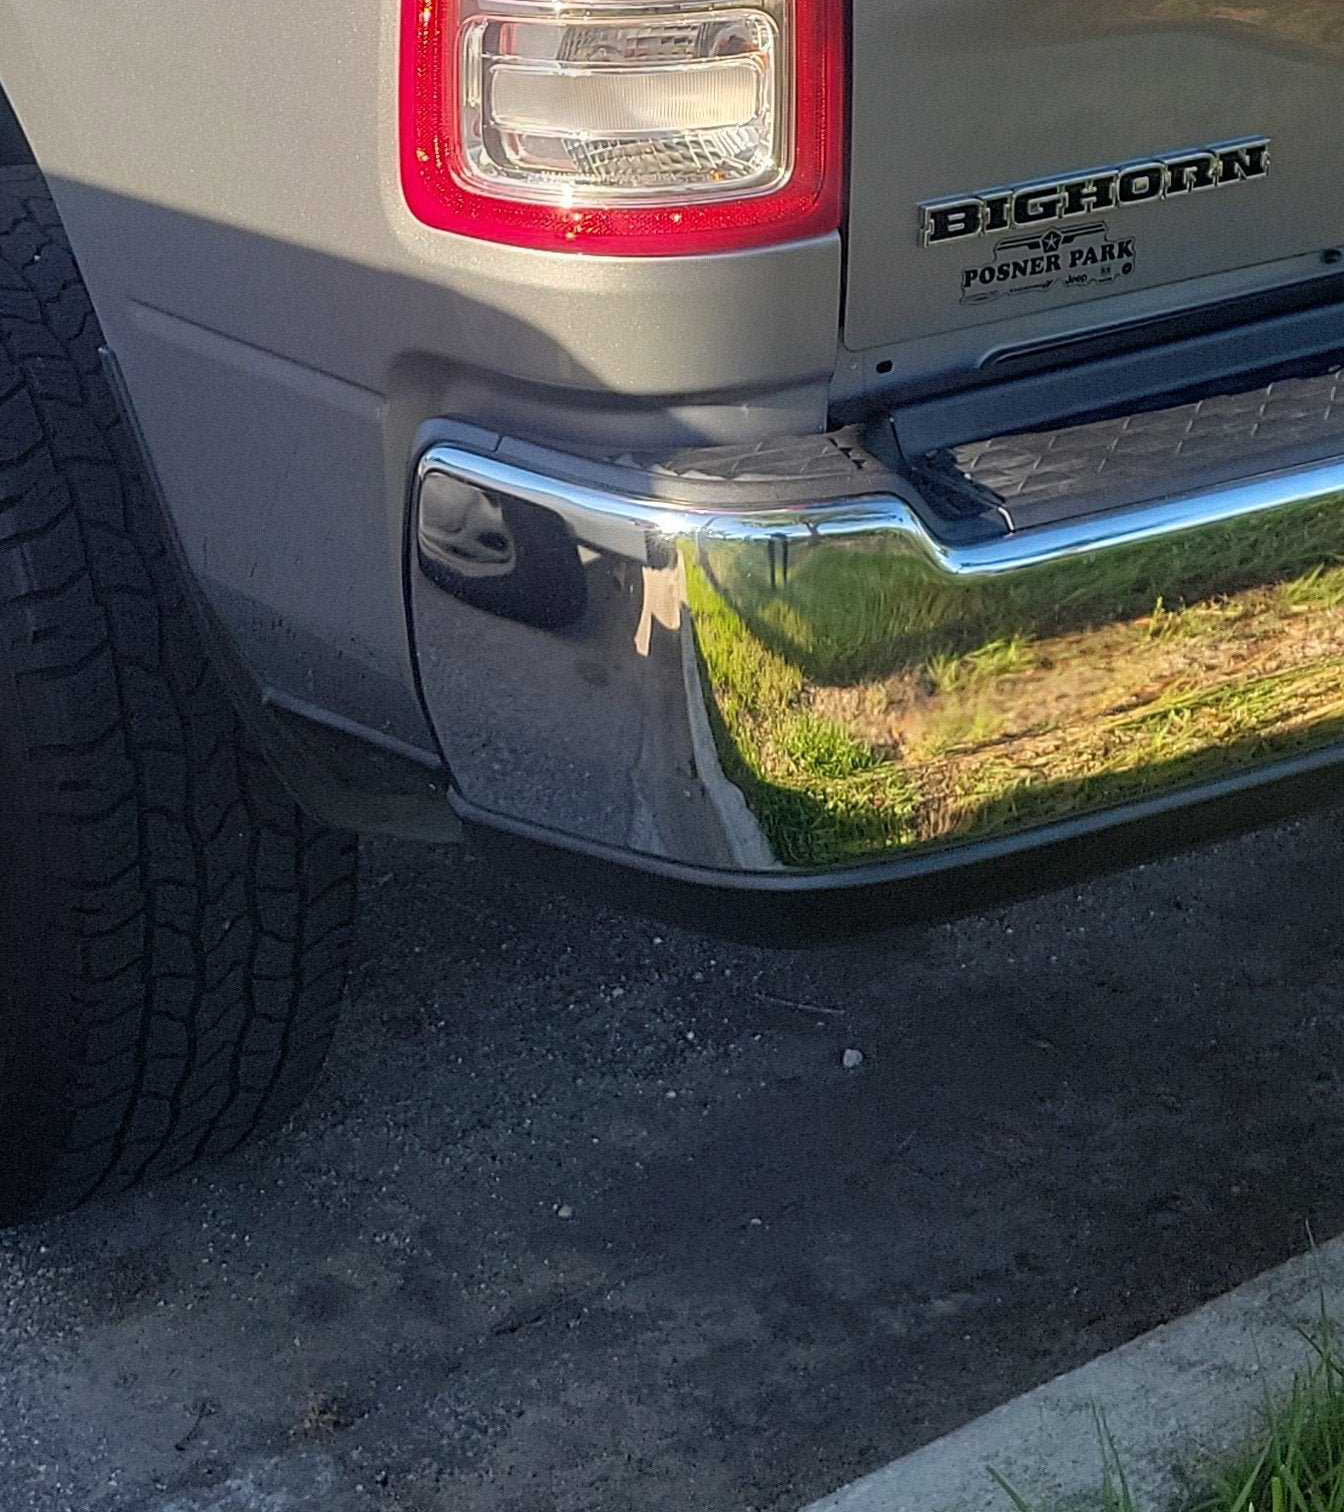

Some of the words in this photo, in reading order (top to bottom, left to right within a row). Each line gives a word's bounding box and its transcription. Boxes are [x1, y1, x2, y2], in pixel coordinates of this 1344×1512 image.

[921, 140, 1270, 245] BIGHORN
[962, 253, 1062, 288] POSNER
[1068, 239, 1135, 268] PARK
